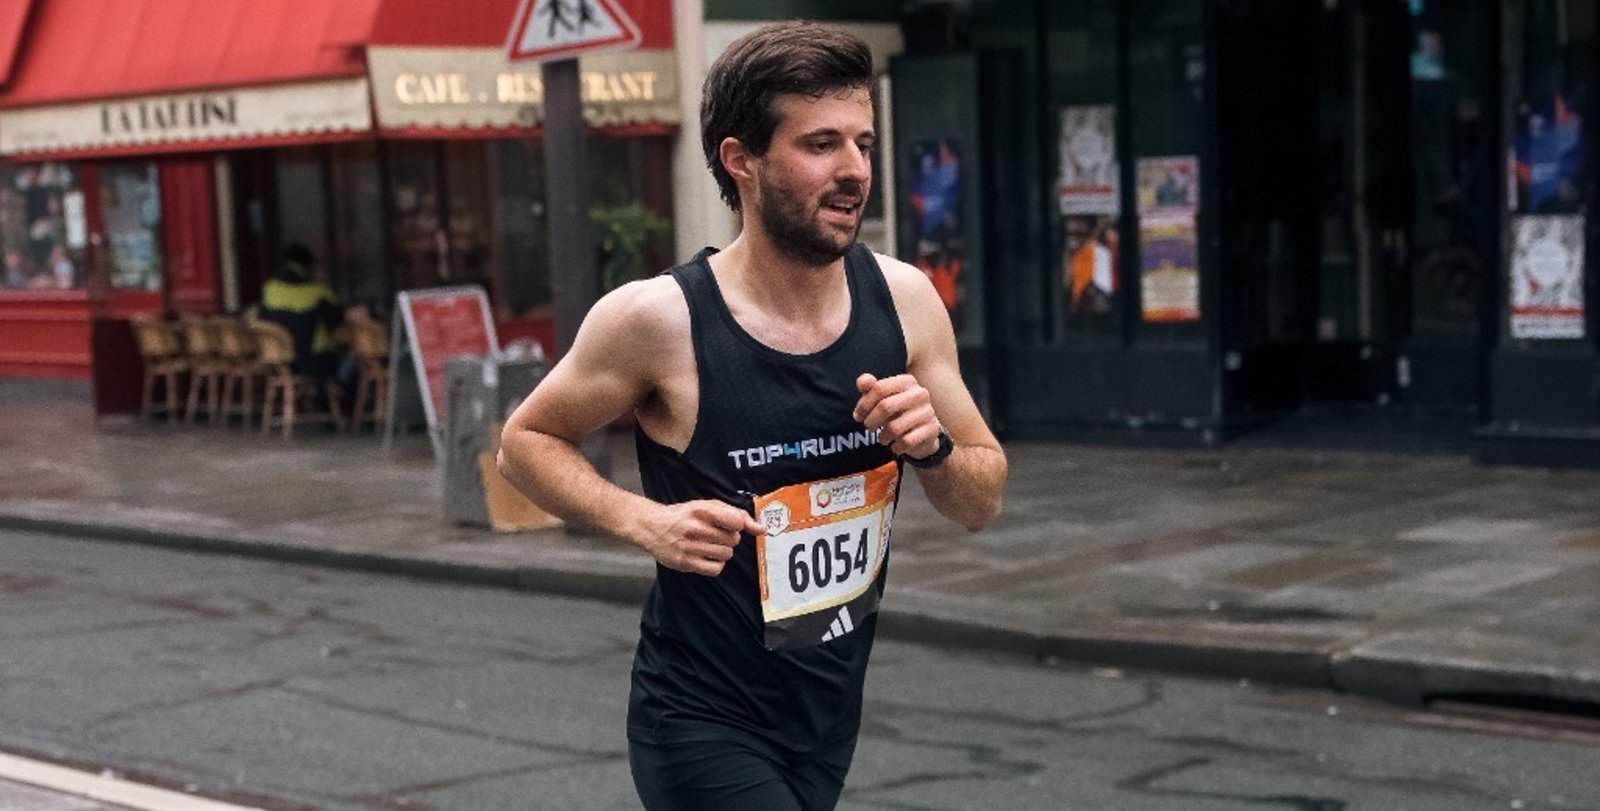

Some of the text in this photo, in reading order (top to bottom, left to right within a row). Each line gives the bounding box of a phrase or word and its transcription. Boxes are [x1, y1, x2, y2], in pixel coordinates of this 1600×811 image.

[497, 72, 656, 103] RESRANT
[728, 425, 884, 469] TOP4RUNNI
[788, 527, 868, 593] 6054
